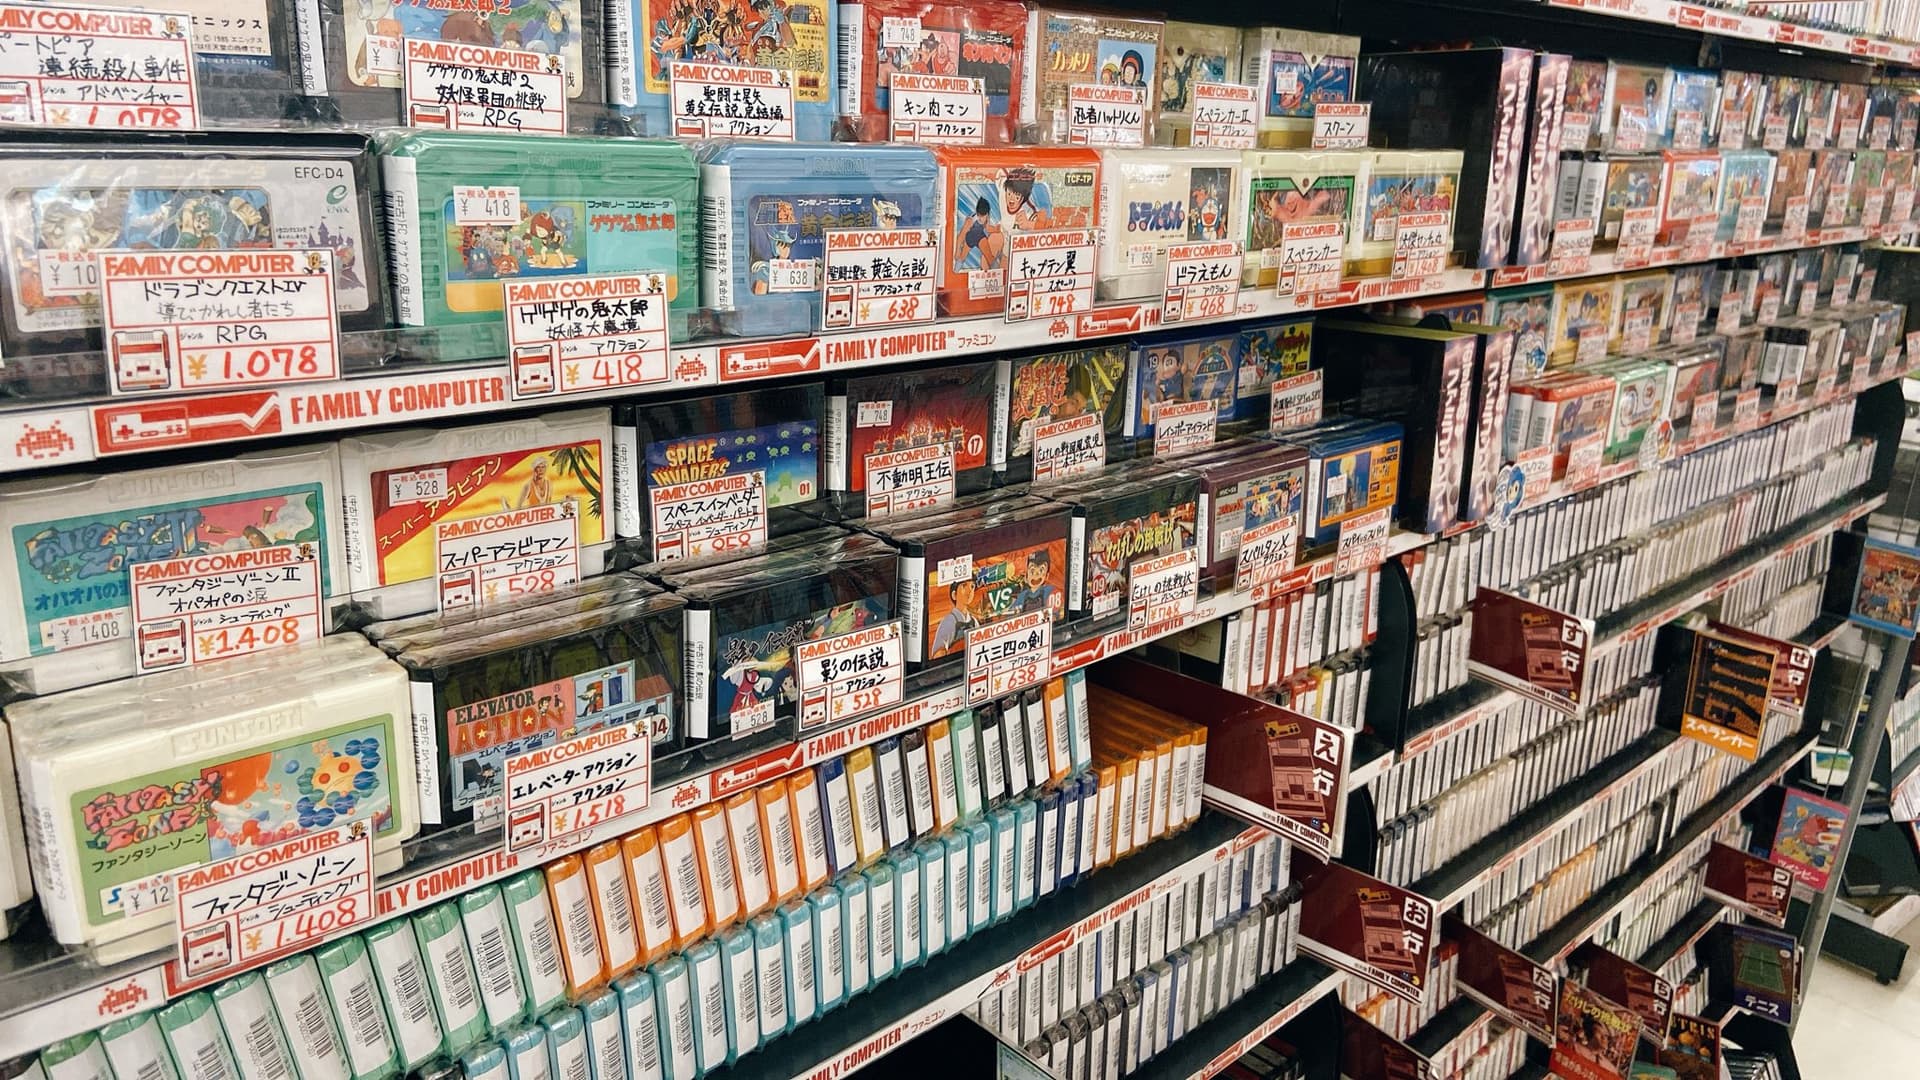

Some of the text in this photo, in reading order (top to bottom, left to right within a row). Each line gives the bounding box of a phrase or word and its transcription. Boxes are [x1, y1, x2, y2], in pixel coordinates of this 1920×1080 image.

[38, 12, 152, 35] COMPUTER
[192, 17, 263, 29] エニックス
[408, 41, 540, 70] FAMILY COMPUTER
[755, 46, 824, 73] 黄金伝説
[39, 57, 187, 82] 連続殺人事件
[673, 64, 773, 84] FAMILY COMPUTER
[892, 75, 969, 91] FAMILY COMPUTER
[1071, 87, 1133, 100] FAMILY COMPUTER
[1216, 86, 1249, 98] COMPUTER
[77, 86, 184, 105] アドベンチャー
[703, 85, 765, 106] 聖闘士星矢
[904, 97, 969, 117] キン肉マン
[483, 108, 522, 131] RPG
[1073, 106, 1140, 124] 忍者ハットリくん
[729, 121, 777, 135] アクション
[936, 124, 976, 135] アクション
[1324, 121, 1355, 136] スクーン
[294, 167, 344, 179] EFC-D4
[1067, 174, 1092, 184] TCF-TP
[485, 199, 511, 216] 418
[1128, 200, 1186, 232] ドラえもん
[590, 213, 675, 233] ゲゲゲの鬼太郎
[1304, 225, 1336, 235] COMPUTER
[828, 232, 922, 247] FAMILY COMPUTER
[1012, 233, 1084, 249] FAMILY COMPUTER
[1168, 245, 1232, 259] FAMILY COMPUTER
[1285, 244, 1339, 264] スペランカー
[105, 254, 294, 276] FAMILY COMPUTER
[871, 257, 929, 280] 黄金伝説
[1020, 250, 1076, 279] キャプテン翼
[1176, 263, 1232, 286] ドラえもん
[1306, 263, 1334, 274] アクション
[790, 271, 808, 285] 638
[1048, 279, 1076, 293] スポーツ
[1362, 282, 1387, 299] FAMILY
[1388, 279, 1419, 295] COMPUTER
[509, 278, 641, 302] FAMILY COMPUTER
[1203, 286, 1230, 295] アクション
[157, 300, 295, 322] 導びかれし者たち
[520, 299, 649, 325] ゲゲゲの鬼太郎
[888, 297, 919, 320] 638
[1049, 294, 1074, 314] 748
[1200, 297, 1225, 317] 968
[180, 325, 267, 343] ジャンル RPG
[545, 318, 641, 340] 妖怪大魔境
[590, 338, 649, 355] アクション
[826, 332, 997, 364] FAMILY COMPUTER ファミコン
[592, 354, 642, 385] 418
[290, 376, 505, 424] FAMILY COMPUTER
[1176, 402, 1208, 414] COMPUTER
[874, 410, 888, 421] 748
[1036, 415, 1093, 438] FAMILY COMPUTER
[666, 439, 717, 467] SPACE
[970, 438, 980, 453] 17
[868, 447, 939, 468] FAMILY COMPUTER
[651, 457, 730, 487] INVADERS
[876, 460, 952, 490] 不動明王伝
[415, 480, 438, 496] 528
[654, 476, 746, 502] FAMILY COMPUTER
[799, 483, 810, 495] 01
[906, 486, 941, 498] アクション
[661, 487, 760, 520] スペースインベーダー
[379, 513, 425, 549] スーパー
[439, 507, 555, 539] FAMILY COMPUTER
[705, 518, 758, 538] シューティング
[1106, 520, 1175, 563] たけしの挑戦状
[1240, 532, 1290, 565] スパルタンX
[135, 548, 291, 581] FAMILY COMPUTER
[442, 536, 568, 571] スーパーアラビアン
[507, 554, 568, 575] アクション
[1132, 553, 1186, 576] FAMILY COMPUTER
[1264, 551, 1288, 566] アクション
[508, 569, 555, 594] 528
[954, 564, 967, 578] 638
[1094, 577, 1105, 594] 09
[168, 587, 267, 613] オパオパの涙
[988, 587, 1012, 611] VS
[220, 603, 290, 625] シューティング
[1159, 601, 1180, 621] 748
[81, 620, 120, 642] 1408
[970, 615, 1038, 644] FAMILY COMPUTER
[1108, 607, 1217, 650] FAMILY COMPUTER ファミコン
[800, 631, 885, 659] FAMILY COMPUTER
[976, 629, 1044, 665] 六三四の剣
[1561, 622, 1582, 673] す行
[820, 646, 889, 683] 影の伝説
[1010, 653, 1042, 670] アクション
[847, 673, 885, 691] アクション
[1008, 666, 1037, 690] 638
[455, 690, 534, 726] ELEVATOR
[853, 687, 882, 711] 528
[455, 704, 565, 751] ACTION
[750, 711, 768, 727] 528
[478, 730, 556, 758] エレベーター アクション
[808, 706, 922, 759] FAMILY COMPUTER
[1684, 716, 1755, 750] スペランカー
[507, 728, 627, 774] FAMILY COMPUTER
[513, 752, 638, 800] エレベーターアクション
[1312, 732, 1338, 798] え行
[572, 778, 626, 805] アクション
[1276, 814, 1300, 834] FAMILY
[1300, 823, 1330, 850] COMPUTER
[92, 833, 208, 872] ファンタジーゾーン
[178, 832, 339, 890] FAMILY COMPUTER
[417, 855, 519, 900] COMPUTER
[1777, 858, 1820, 883] ツインビー
[193, 858, 356, 920] ファンタジーゾーン
[269, 874, 361, 920] シューティング
[1077, 891, 1151, 938] FAMILY COMPUTER
[1402, 900, 1428, 955] お行
[1367, 965, 1390, 984] FAMILY
[1390, 973, 1420, 1000] COMPUTER
[1534, 968, 1552, 1010] た行
[1745, 996, 1779, 1017] テニス
[844, 1009, 946, 1072] COMPUTER ファミコン
